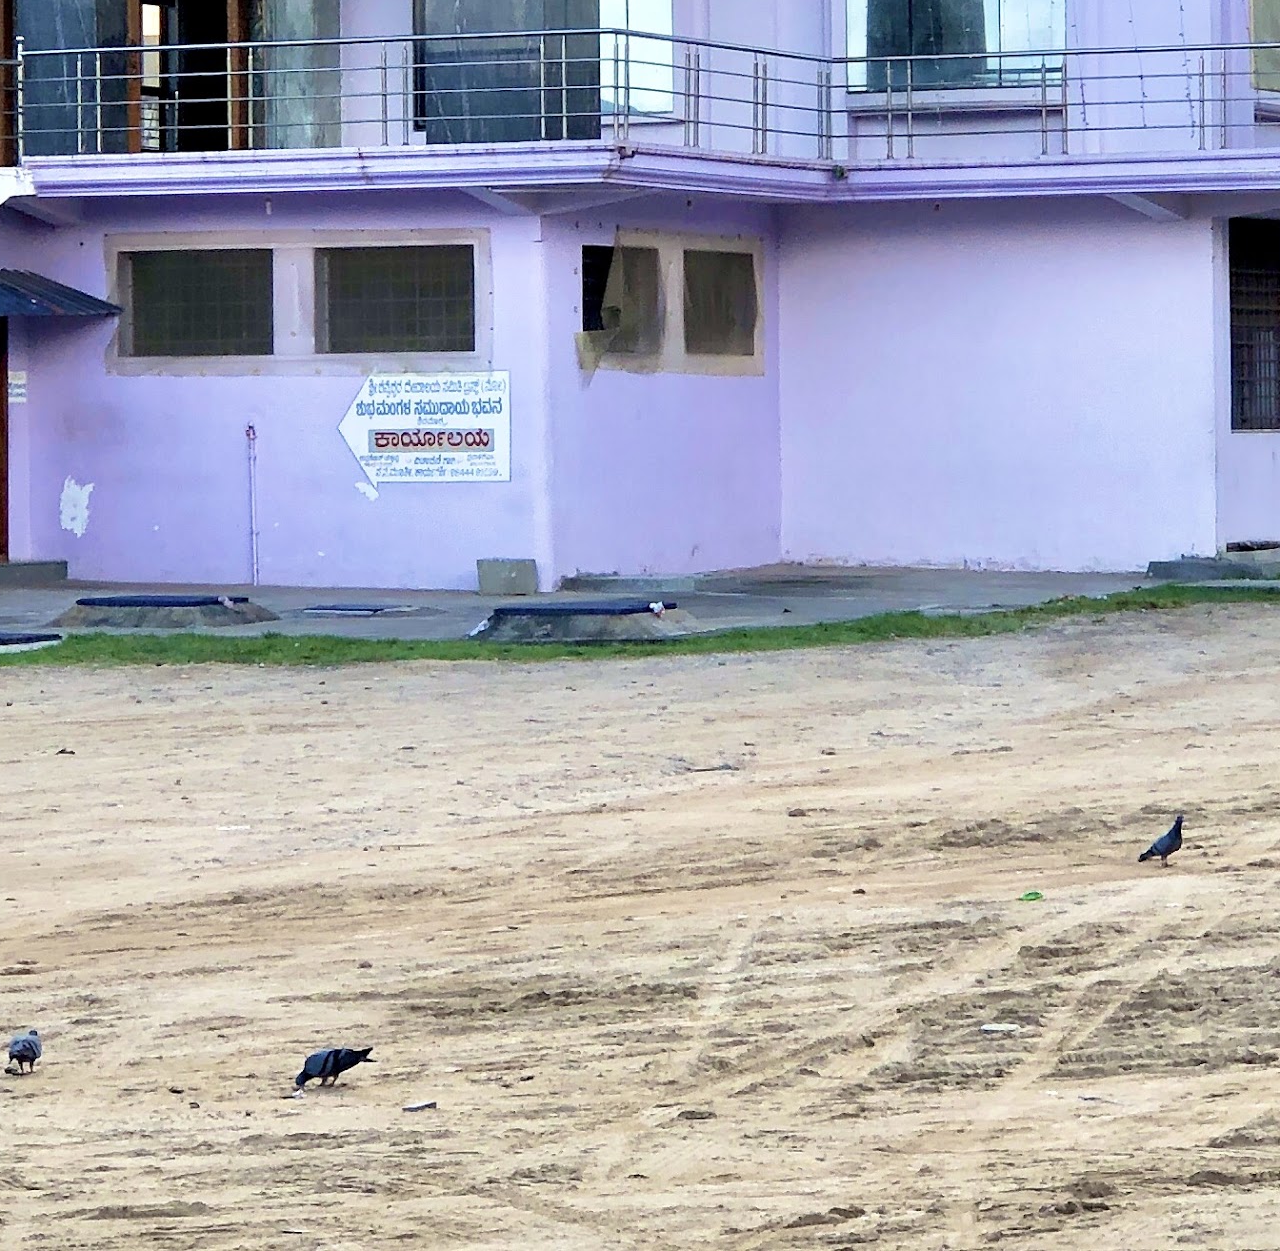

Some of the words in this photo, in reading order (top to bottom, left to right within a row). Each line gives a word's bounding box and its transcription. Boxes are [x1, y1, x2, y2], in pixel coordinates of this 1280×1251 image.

[414, 398, 470, 416] ಸಮುದಾಯ
[471, 397, 503, 418] ಭವನ
[374, 428, 490, 448] ಕಾರ್ಯಾಲಯ
